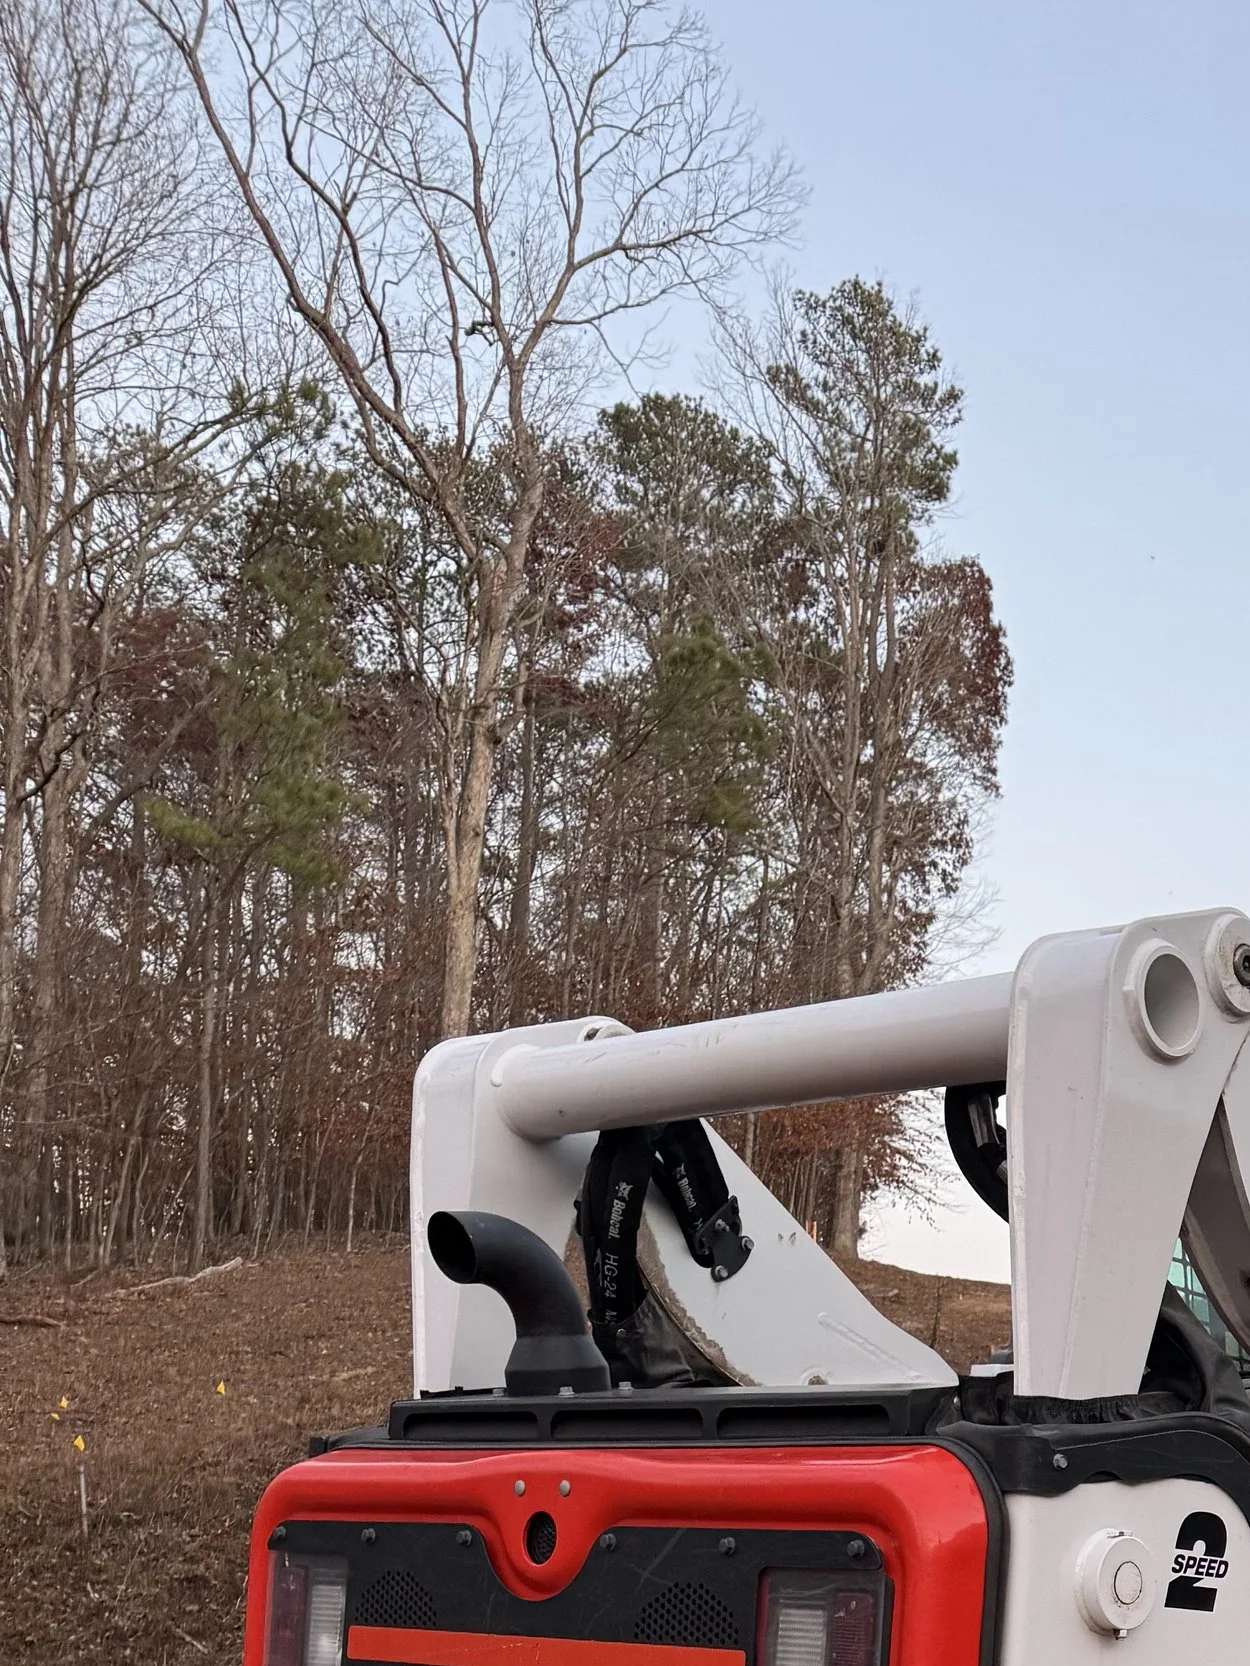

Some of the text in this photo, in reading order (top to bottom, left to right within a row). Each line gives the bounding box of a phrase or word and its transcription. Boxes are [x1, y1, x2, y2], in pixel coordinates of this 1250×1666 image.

[608, 1198, 626, 1239] Bobcat
[604, 1252, 620, 1299] HG-24
[1164, 1511, 1227, 1612] 2
[1171, 1553, 1229, 1579] SPEED
